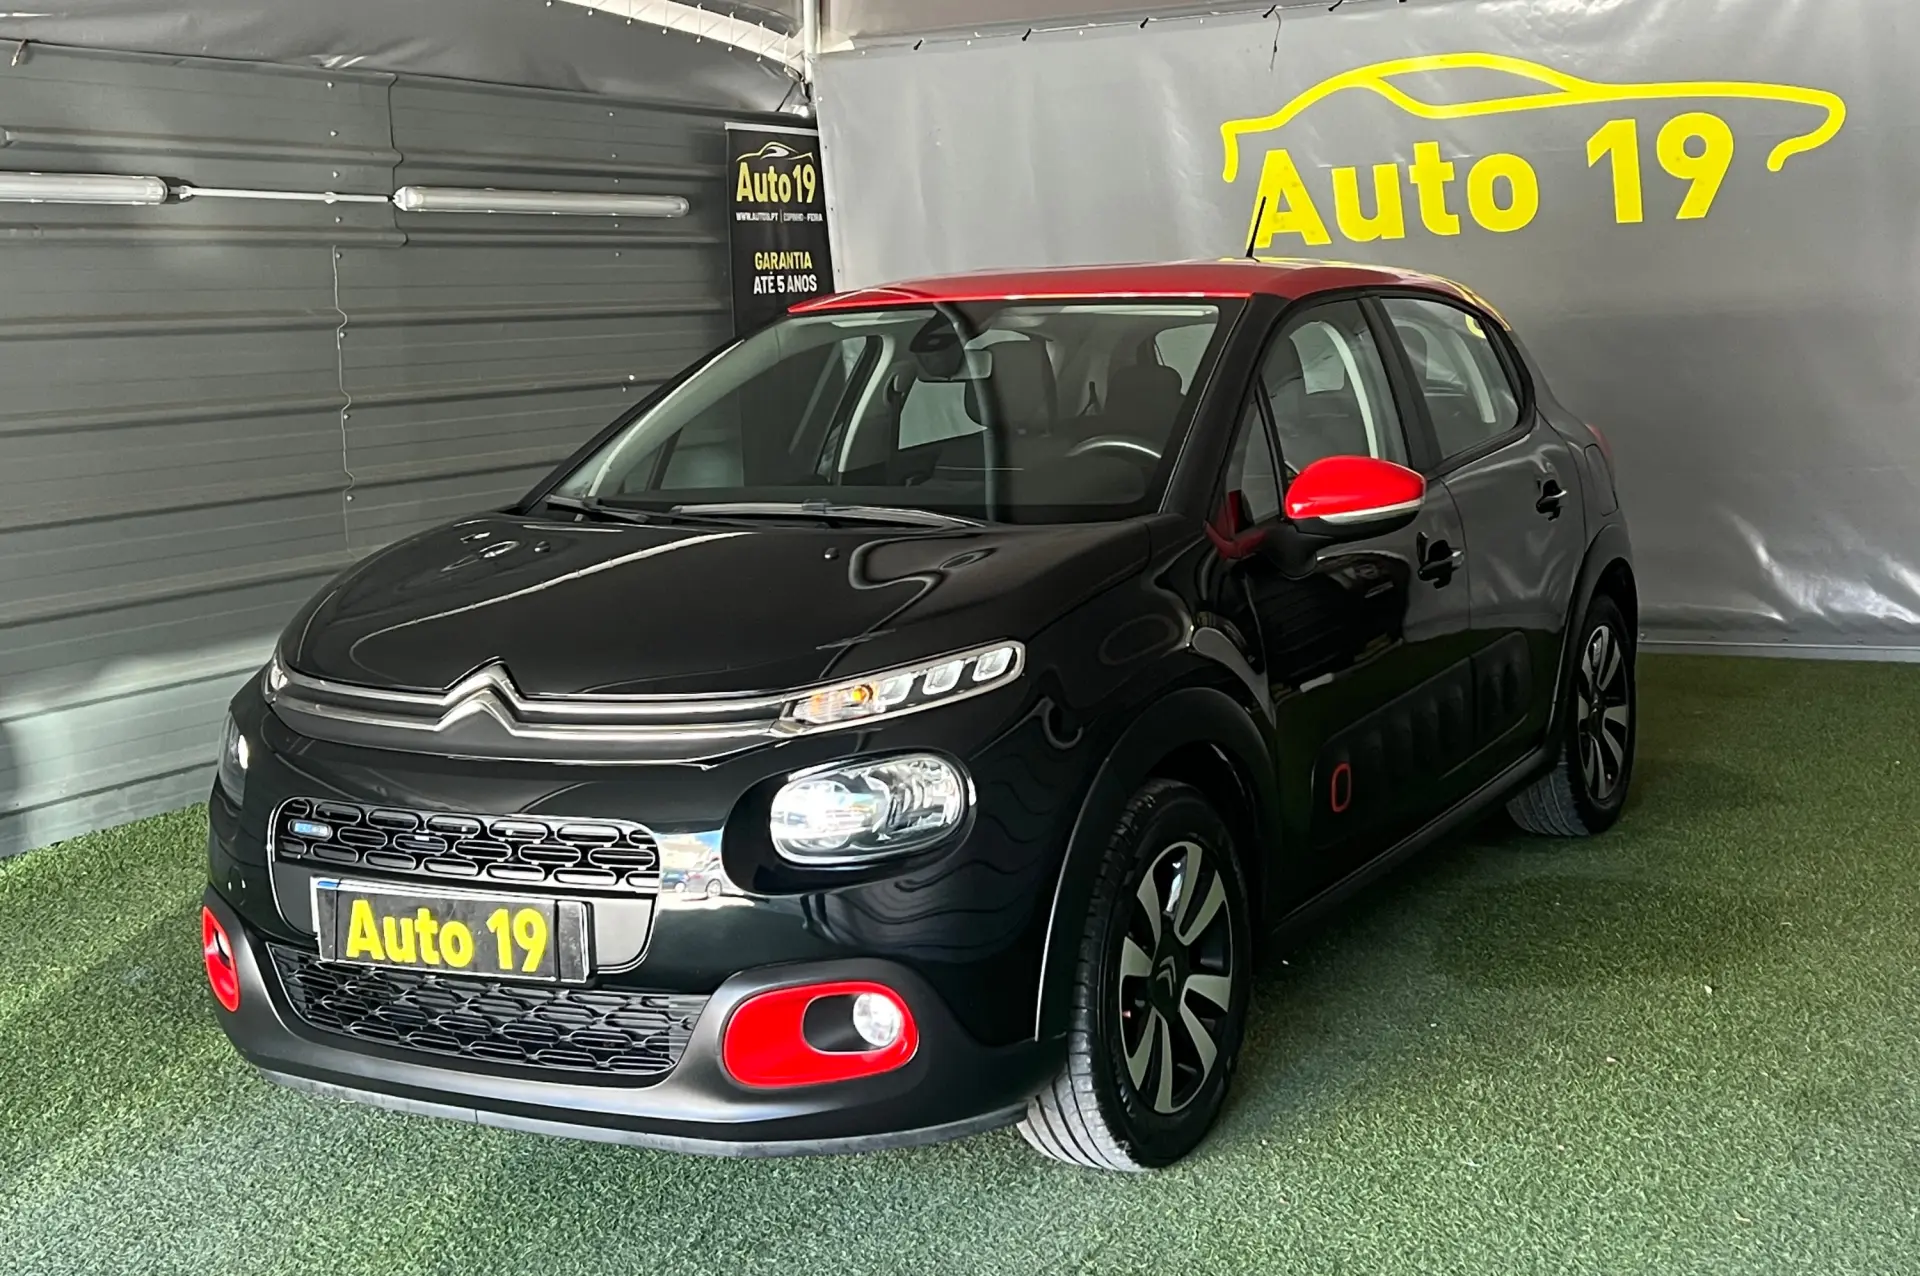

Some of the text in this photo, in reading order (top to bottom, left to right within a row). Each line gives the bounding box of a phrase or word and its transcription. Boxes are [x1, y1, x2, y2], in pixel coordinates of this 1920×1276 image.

[736, 162, 816, 203] Auto 19
[1246, 111, 1735, 249] Auto 19
[755, 251, 812, 270] GARANTIA
[753, 271, 817, 294] ATÉ 5 ANOS
[345, 898, 549, 973] Auto 19
